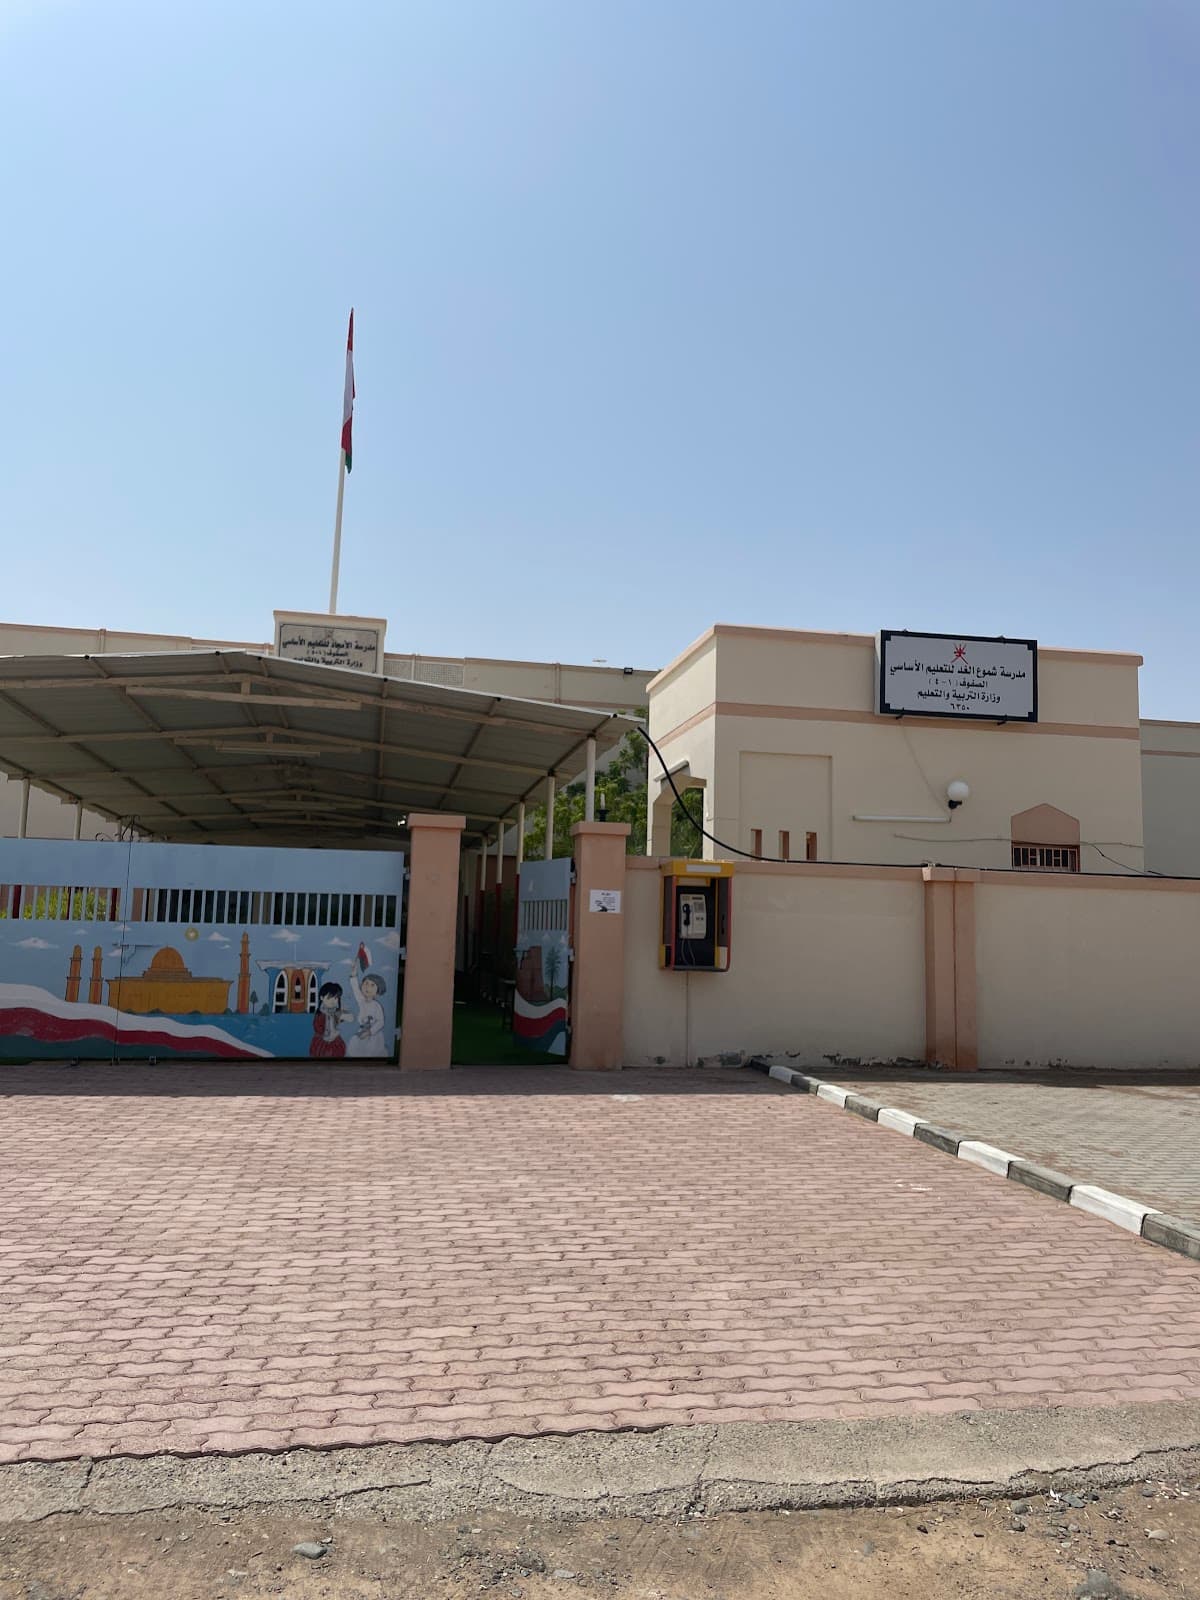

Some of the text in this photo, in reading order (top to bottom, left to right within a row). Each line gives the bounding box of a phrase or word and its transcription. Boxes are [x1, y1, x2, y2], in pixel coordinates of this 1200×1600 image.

[890, 660, 1026, 680] مدرسة شموع الغد للتعليم الأساسي
[959, 678, 988, 688] الصفوف
[917, 688, 1001, 704] وزارة التربية والتعليم
